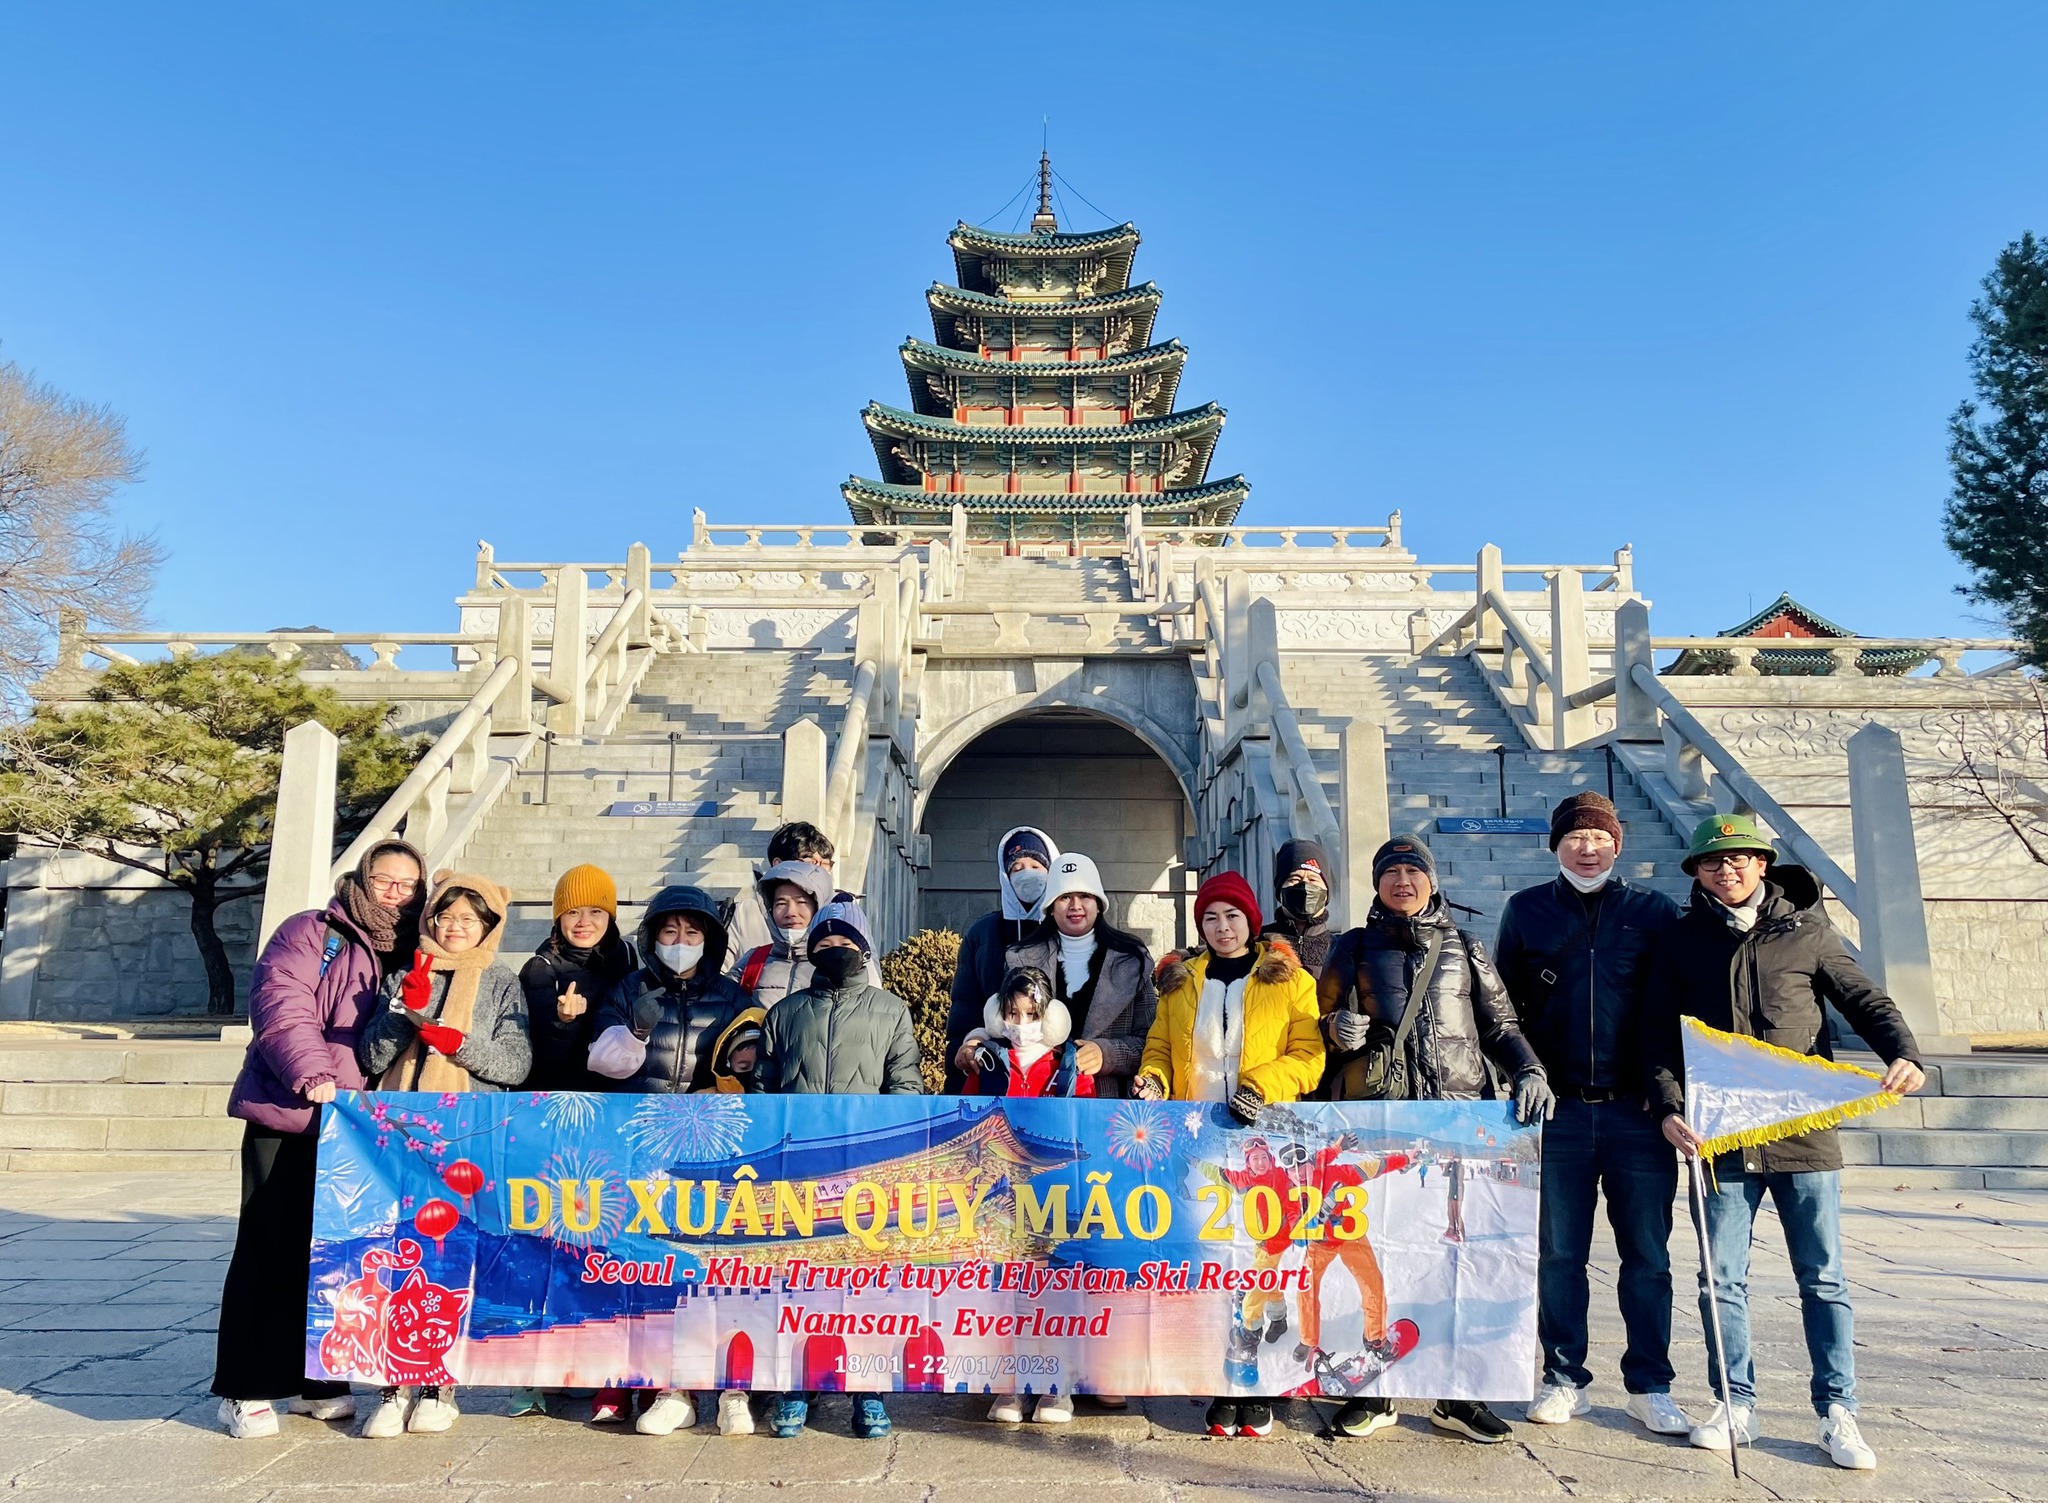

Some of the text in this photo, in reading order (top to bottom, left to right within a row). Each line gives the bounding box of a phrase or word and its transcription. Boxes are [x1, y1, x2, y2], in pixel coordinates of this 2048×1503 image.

[506, 1164, 1370, 1251] DU XUÂN QUÝ MÃO 2023
[582, 1253, 676, 1286] Seoul
[705, 1256, 776, 1289] Khu
[786, 1258, 891, 1296] Trượt
[899, 1258, 992, 1297] tuyết
[999, 1260, 1126, 1299] Elysian
[1136, 1260, 1190, 1292] Ski
[1198, 1261, 1312, 1292] Resort
[777, 1306, 922, 1337] Namsan
[952, 1307, 1113, 1337] Everland
[834, 1354, 901, 1378] 18/01
[922, 1354, 1060, 1379] 22/01/2023
